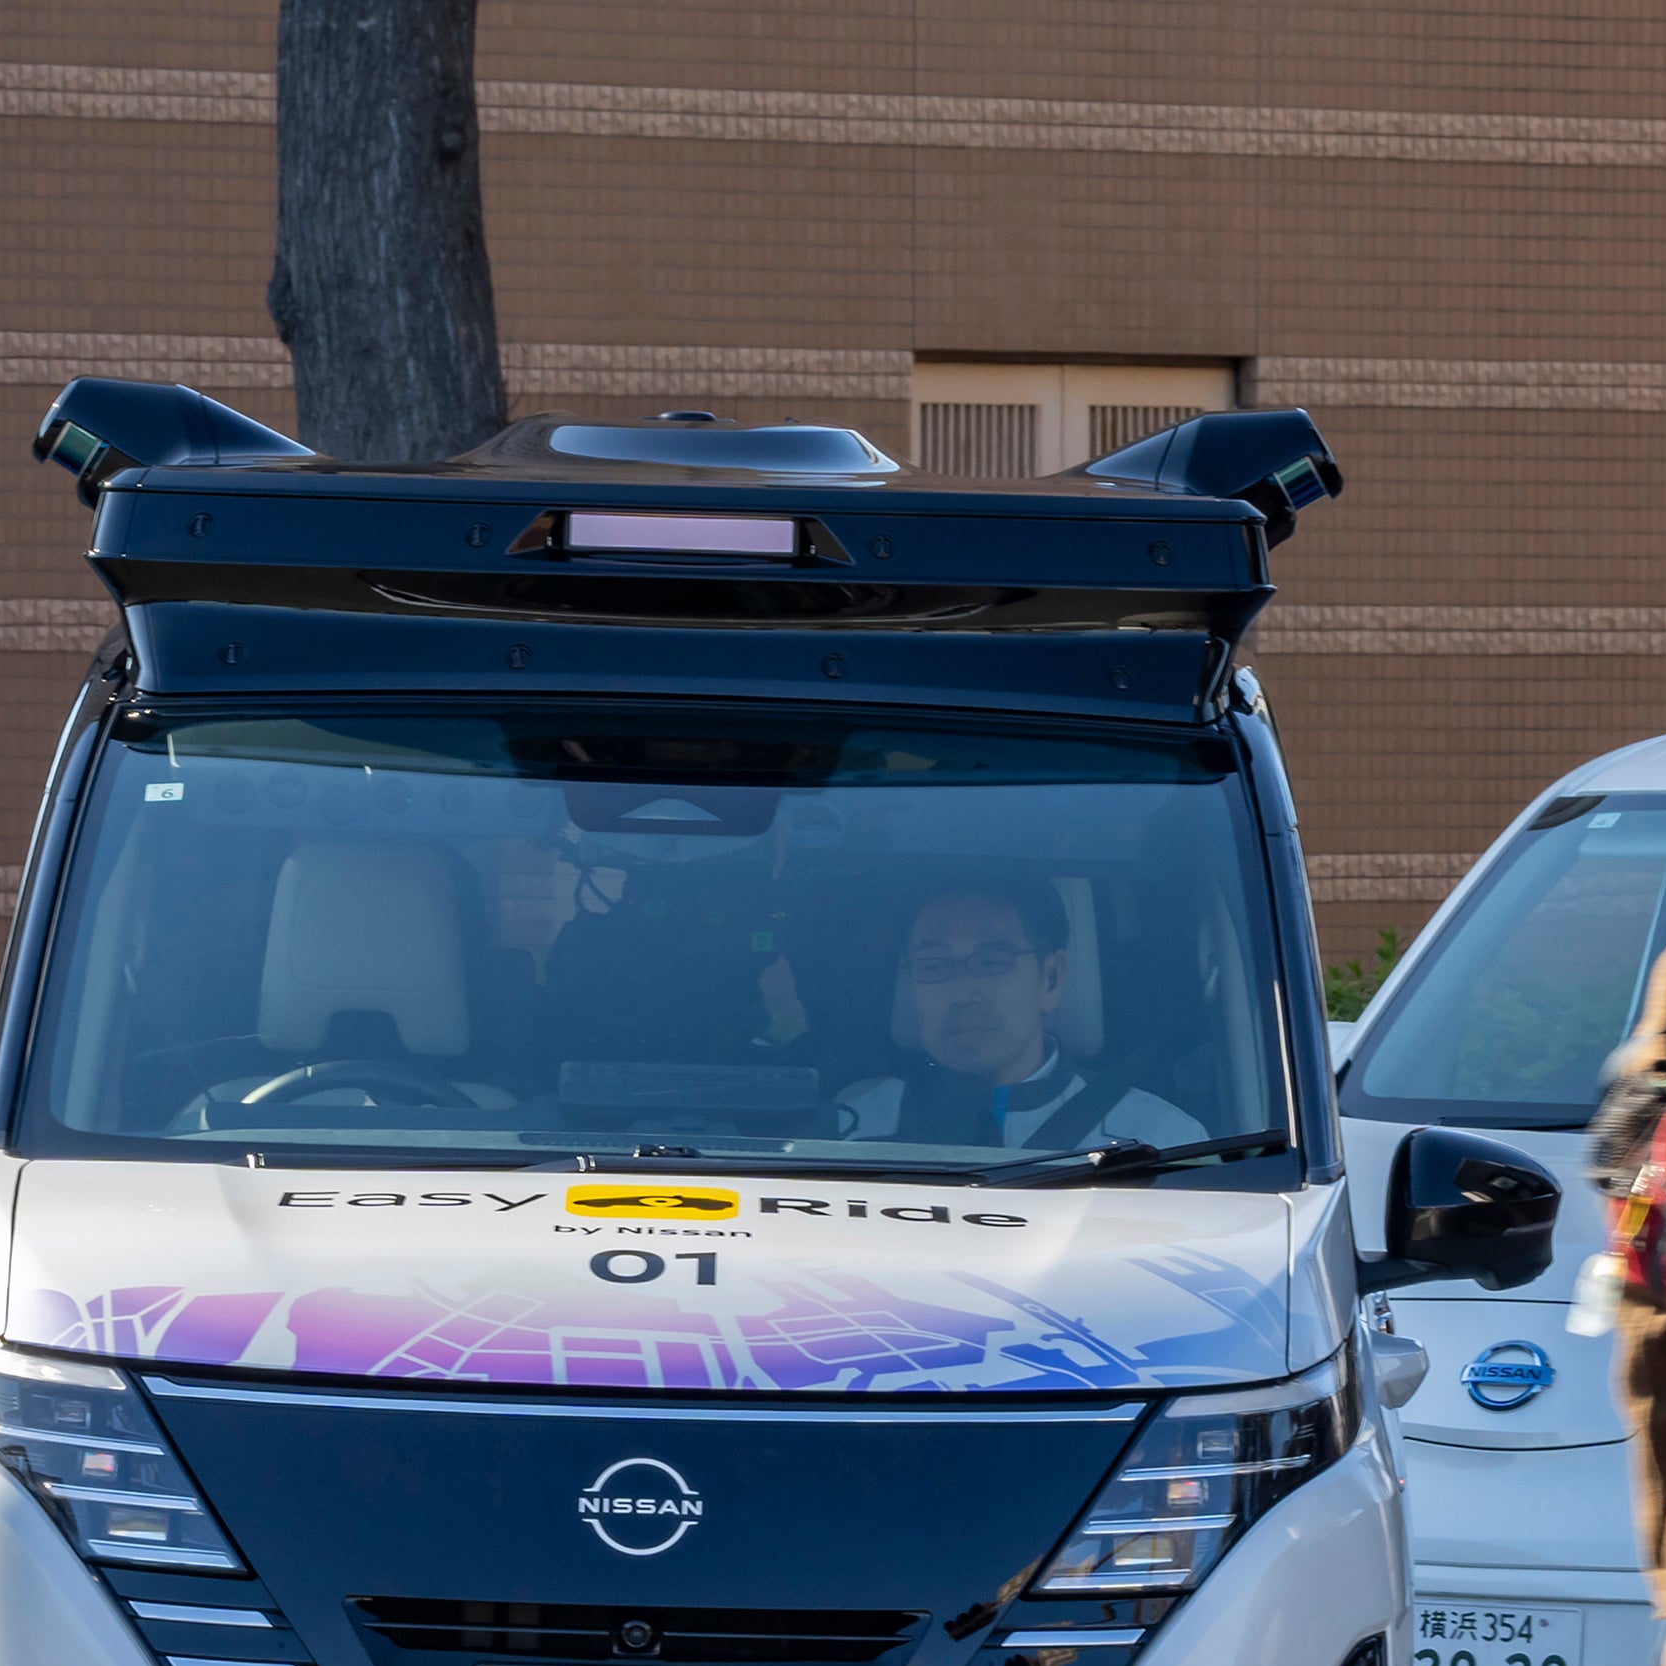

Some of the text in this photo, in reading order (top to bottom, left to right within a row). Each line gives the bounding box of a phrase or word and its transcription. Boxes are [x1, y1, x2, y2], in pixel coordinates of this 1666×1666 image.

[278, 1190, 1029, 1228] Easy Ride
[552, 1224, 752, 1239] by Nissan
[589, 1249, 717, 1286] 01
[1467, 1366, 1542, 1380] NISSAN
[578, 1497, 703, 1516] NISSAN
